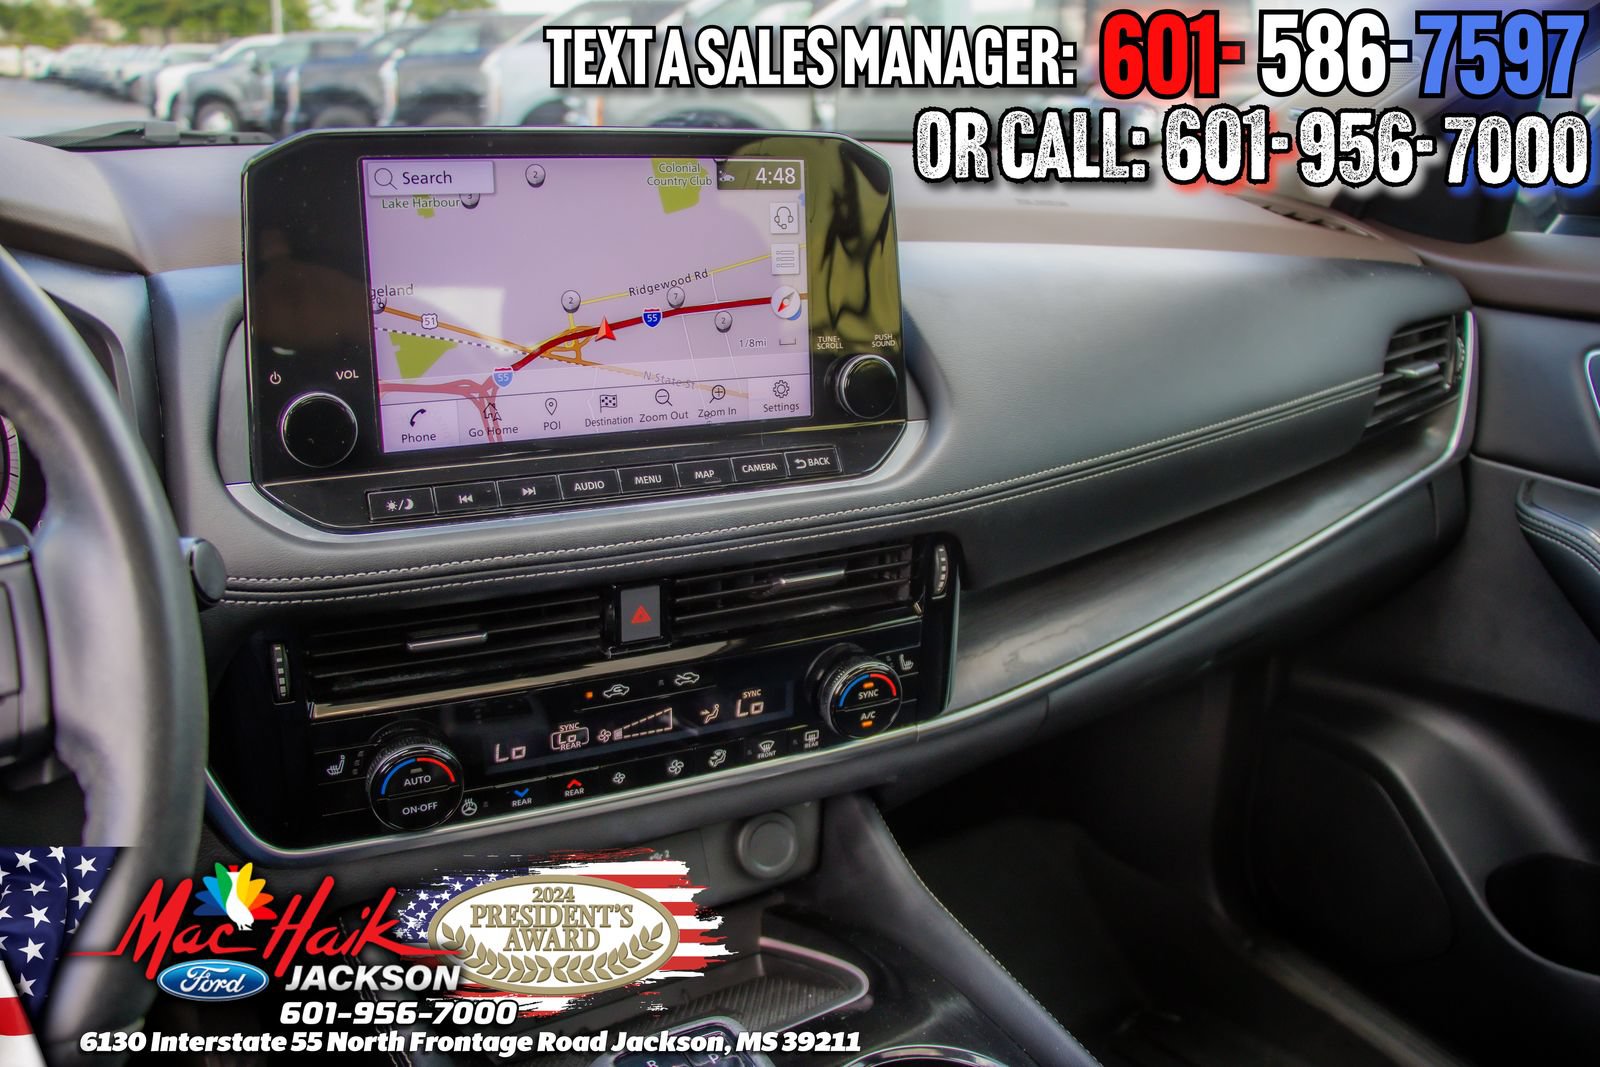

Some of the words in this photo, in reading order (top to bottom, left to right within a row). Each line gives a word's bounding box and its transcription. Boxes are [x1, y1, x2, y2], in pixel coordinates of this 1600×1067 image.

[659, 163, 700, 173] Colonial
[402, 171, 452, 185] Search
[755, 167, 796, 184] 4:48
[647, 176, 688, 188] Country
[690, 176, 712, 186] Club
[382, 199, 409, 208] Lake
[412, 198, 460, 208] Harbour
[628, 273, 691, 296] Ridgewood
[694, 269, 709, 280] Rd
[424, 317, 436, 326] 51
[647, 313, 658, 322] 55
[874, 333, 893, 341] PUSH
[739, 339, 767, 348] 1/8mi
[817, 342, 843, 350] SCROLL
[872, 340, 896, 348] SOUND
[336, 370, 359, 380] VOL
[497, 374, 509, 382] 55
[643, 371, 652, 380] N
[698, 408, 726, 418] Zoom
[727, 407, 737, 416] In
[763, 402, 800, 413] Settings
[585, 414, 633, 427] Destination
[639, 413, 668, 423] Zoom
[670, 410, 689, 420] Out
[468, 428, 483, 438] Go
[486, 424, 519, 436] Home
[544, 421, 561, 431] POI
[401, 432, 436, 444] Phone
[807, 456, 831, 467] BACK
[741, 462, 778, 473] CAMERA
[695, 469, 715, 479] MAP
[634, 474, 662, 485] MENU
[574, 480, 605, 491] AUDIO
[742, 689, 762, 698] SYNC
[858, 688, 879, 700] SYNC
[736, 699, 764, 718] Lo
[860, 710, 876, 720] A/C
[559, 722, 580, 731] SYNC
[560, 741, 582, 750] REAR
[804, 741, 819, 749] REAR
[495, 743, 526, 763] Lo
[757, 750, 776, 760] FRONT
[404, 775, 431, 786] AUTO
[565, 787, 584, 797] REAR
[512, 798, 532, 808] REAR
[708, 1053, 720, 1065] P
